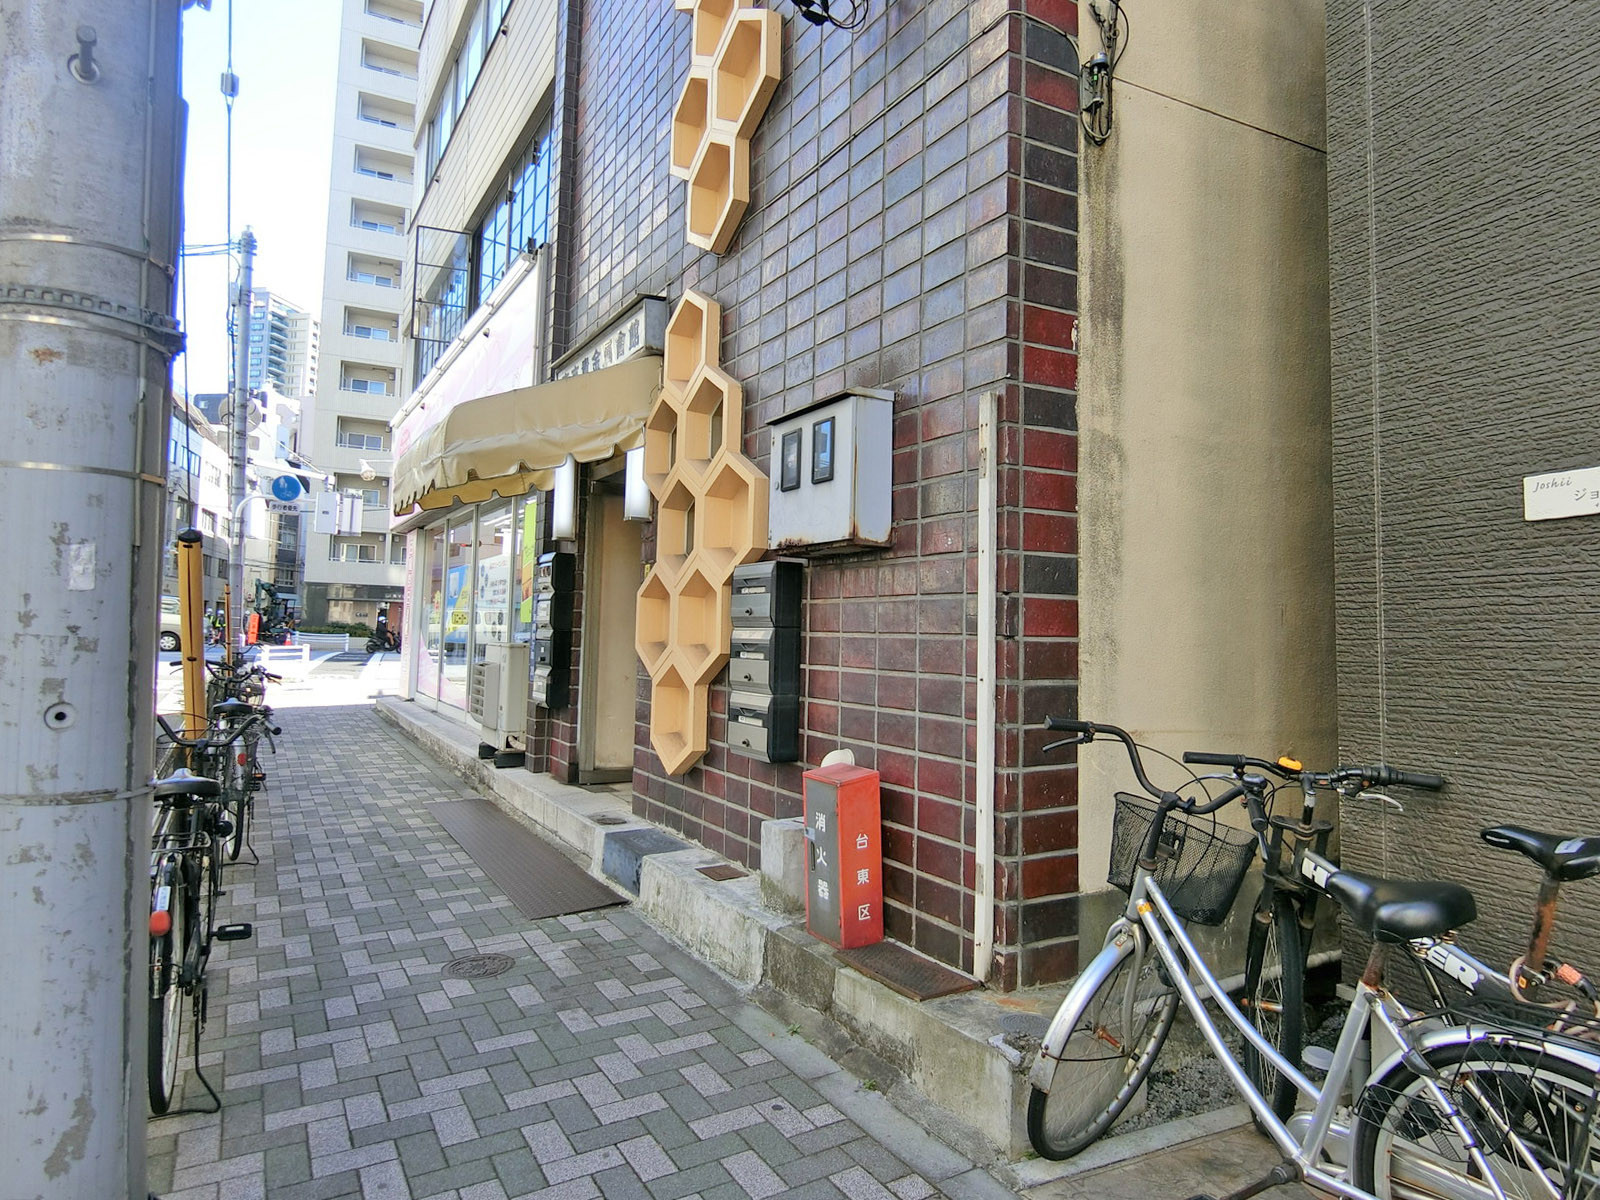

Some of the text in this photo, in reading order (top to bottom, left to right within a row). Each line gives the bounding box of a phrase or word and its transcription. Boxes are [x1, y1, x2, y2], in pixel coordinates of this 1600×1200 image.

[1532, 477, 1573, 493] Joshii
[815, 812, 830, 900] 消火器
[856, 833, 871, 921] 台東区
